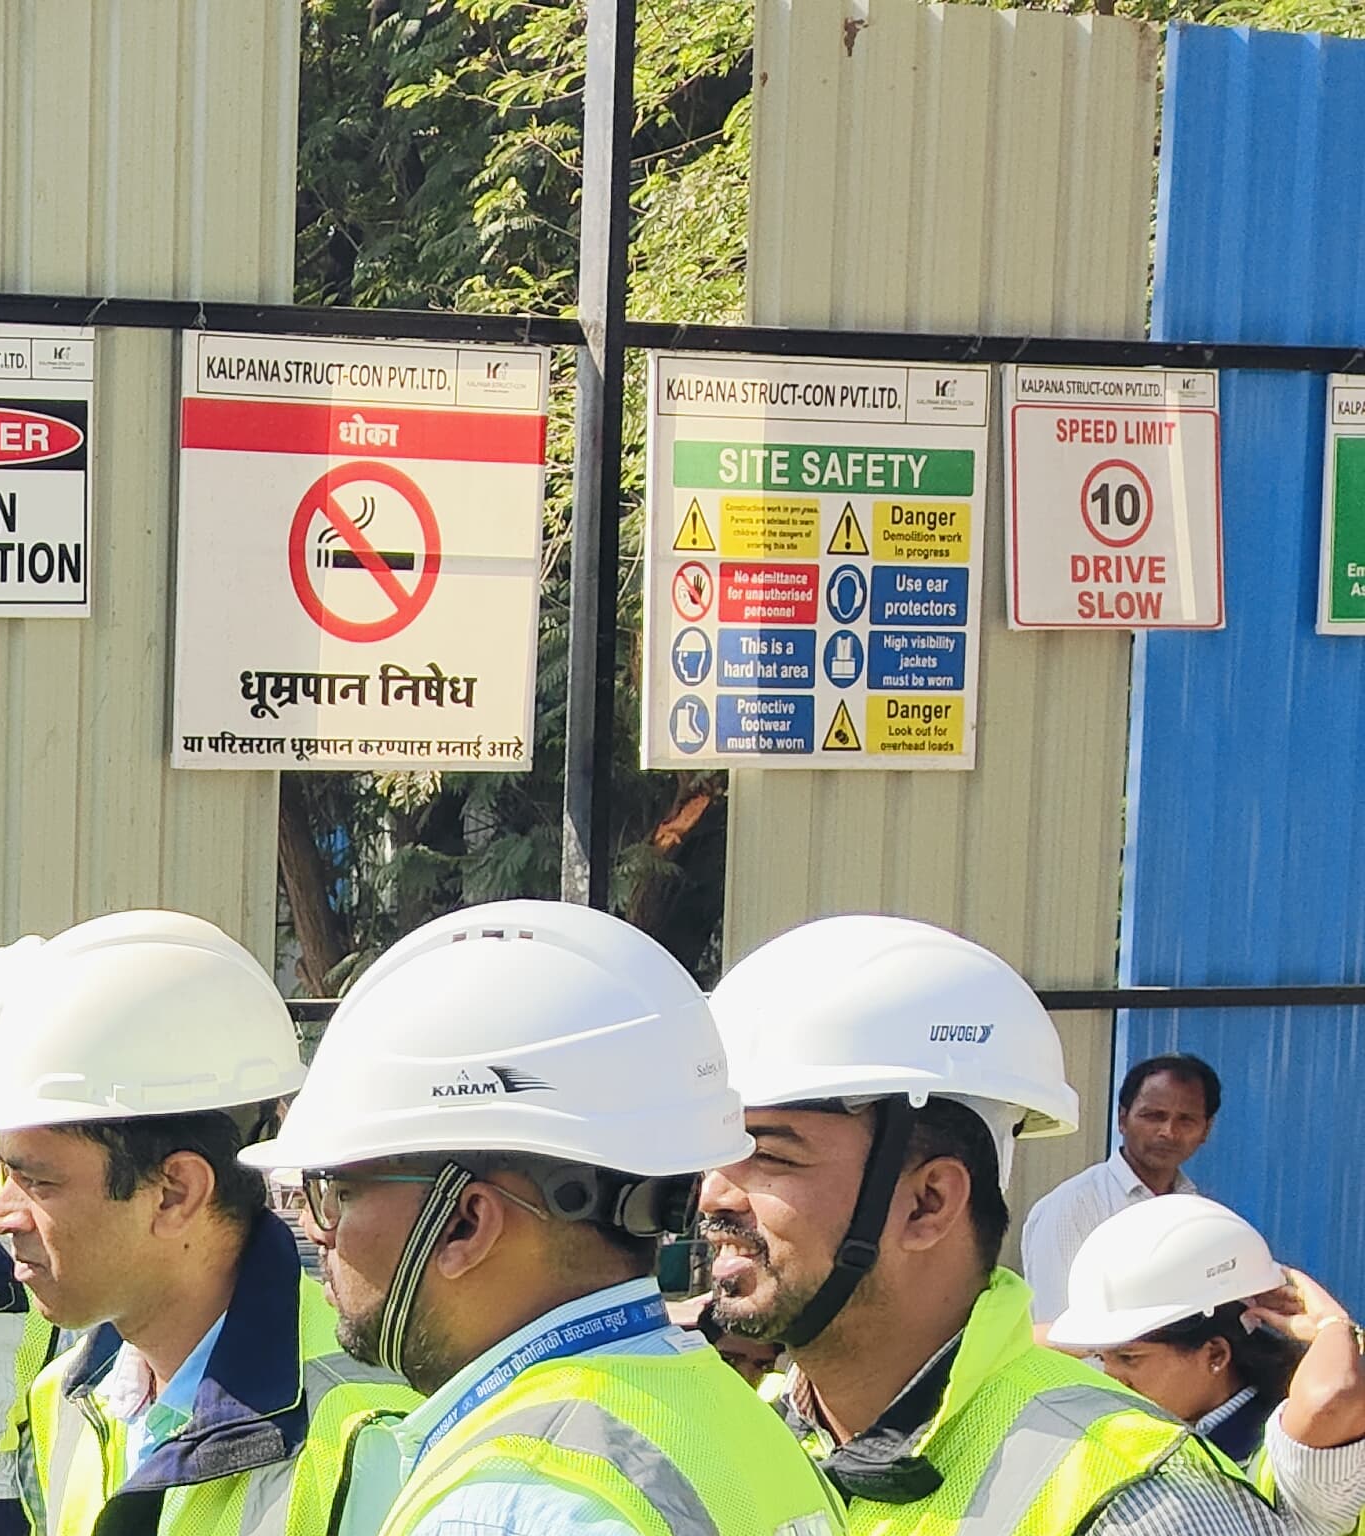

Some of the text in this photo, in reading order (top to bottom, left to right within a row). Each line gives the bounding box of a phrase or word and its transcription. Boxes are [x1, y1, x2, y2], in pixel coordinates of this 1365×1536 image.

[206, 355, 283, 383] KALPANA
[283, 361, 383, 388] STRUCT-CON
[667, 378, 737, 404] KALPANA
[741, 382, 836, 407] STRUCT-CON
[1021, 378, 1065, 394] KALPANA
[1066, 381, 1123, 396] STRUCT-CON
[339, 413, 400, 447] धोका
[1056, 418, 1176, 446] SPEED LIMIT
[718, 448, 928, 488] SITE SAFETY
[1091, 483, 1141, 527] 10
[891, 505, 956, 530] Danger
[883, 530, 963, 543] Demolition work
[906, 547, 950, 559] progress
[734, 570, 808, 584] No admittance
[1071, 555, 1166, 584] DRIVE
[896, 574, 948, 592] Use ear
[727, 586, 813, 601] for unauthorised
[744, 606, 795, 619] personnel
[885, 601, 956, 617] protectors
[1077, 591, 1163, 619] SLOW
[740, 637, 794, 655] This is a
[883, 635, 956, 652] High visibility
[724, 660, 809, 678] hard hat area
[899, 655, 937, 670] jackets
[882, 674, 953, 686] must be worn
[240, 661, 478, 719] धूम्रपान निषेध
[737, 699, 795, 714] Protective
[887, 699, 951, 722] Danger
[741, 716, 791, 733] footwear
[888, 725, 948, 737] Look out for
[182, 730, 524, 763] या परिसरात धूम्रपान करण्यास मनाई आहे
[727, 736, 805, 750] must be worn
[880, 741, 924, 751] overhead
[930, 1025, 977, 1042] UDYOGI
[431, 1081, 497, 1097] KARAM
